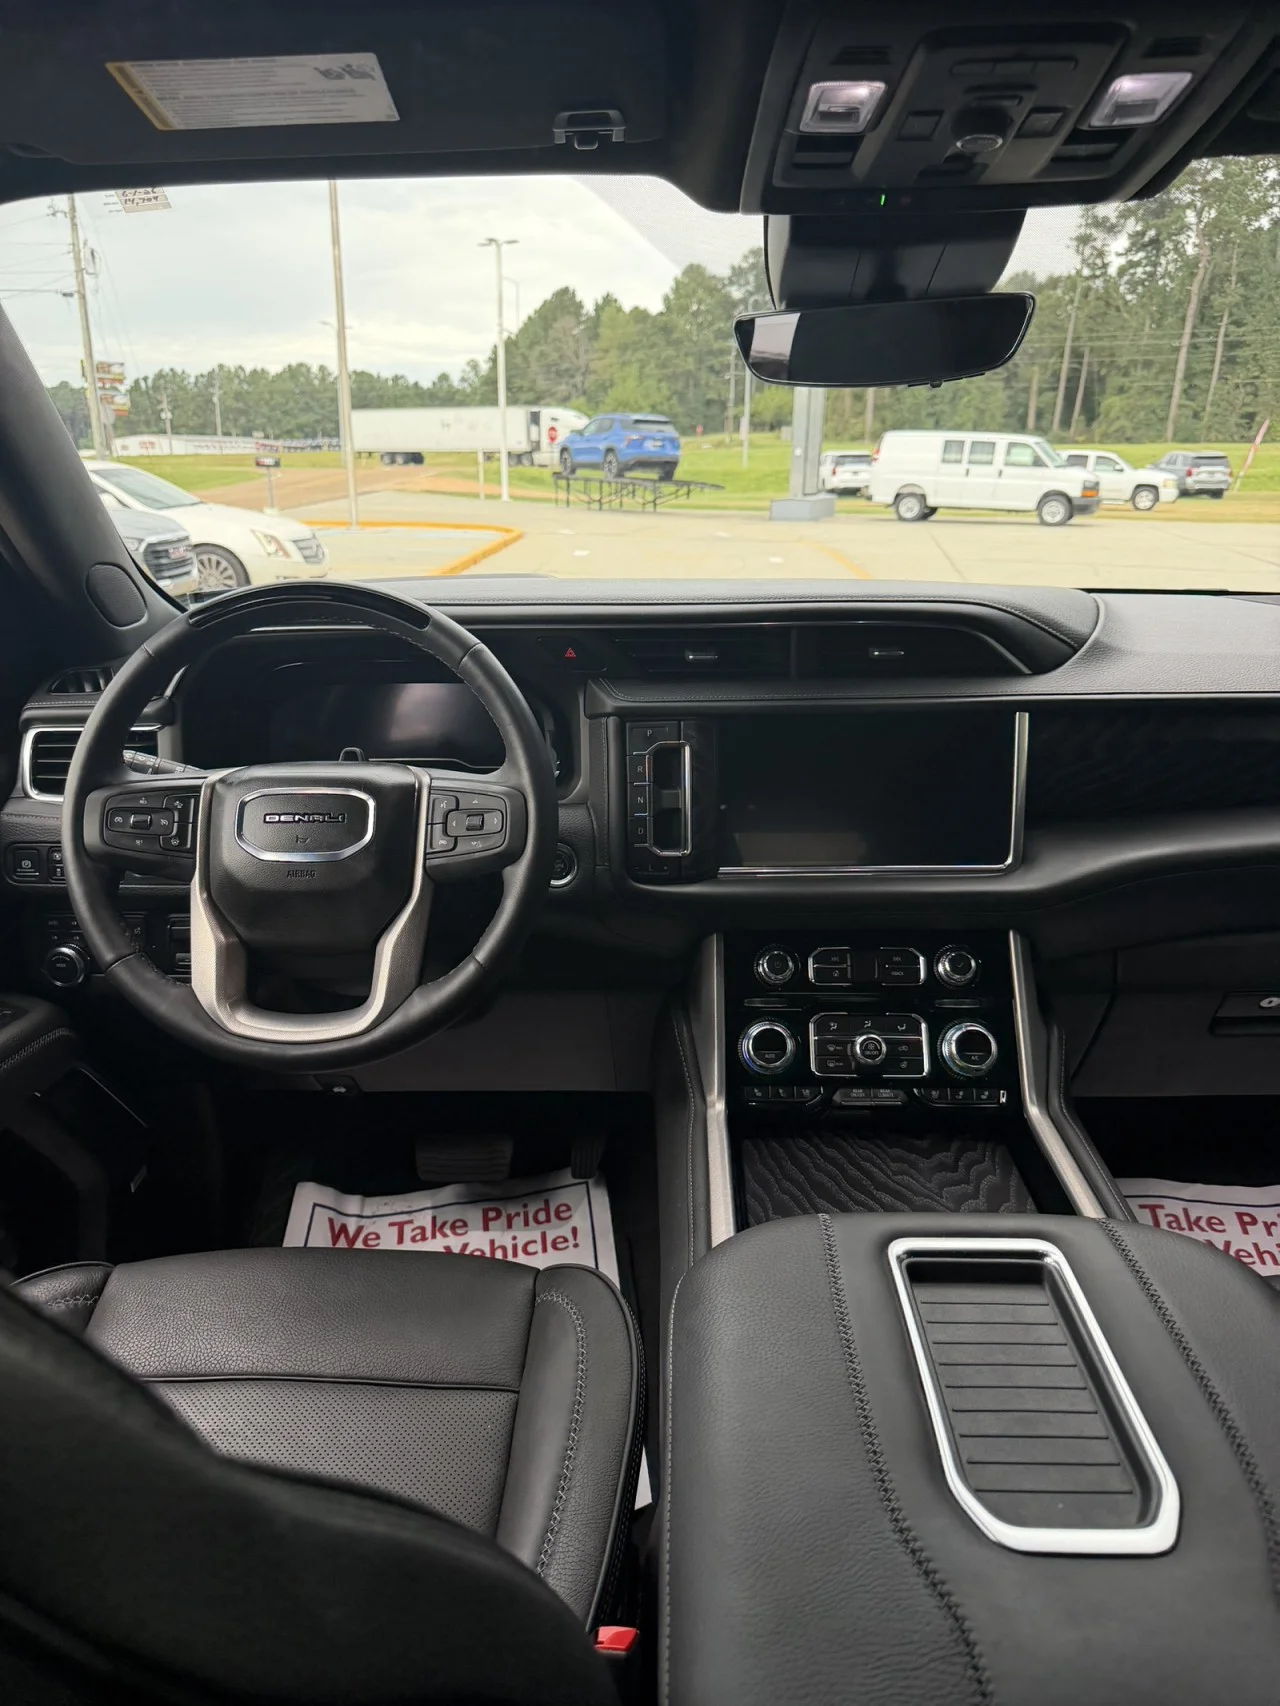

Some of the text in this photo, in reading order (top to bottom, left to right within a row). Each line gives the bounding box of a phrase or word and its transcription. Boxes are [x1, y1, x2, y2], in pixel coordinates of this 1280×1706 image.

[637, 765, 643, 773] R
[637, 796, 644, 804] N
[264, 813, 347, 823] DENALI
[637, 827, 644, 835] D
[286, 869, 317, 879] AIRBAG
[327, 1198, 573, 1249] We Take Pride
[1138, 1203, 1227, 1234] Take
